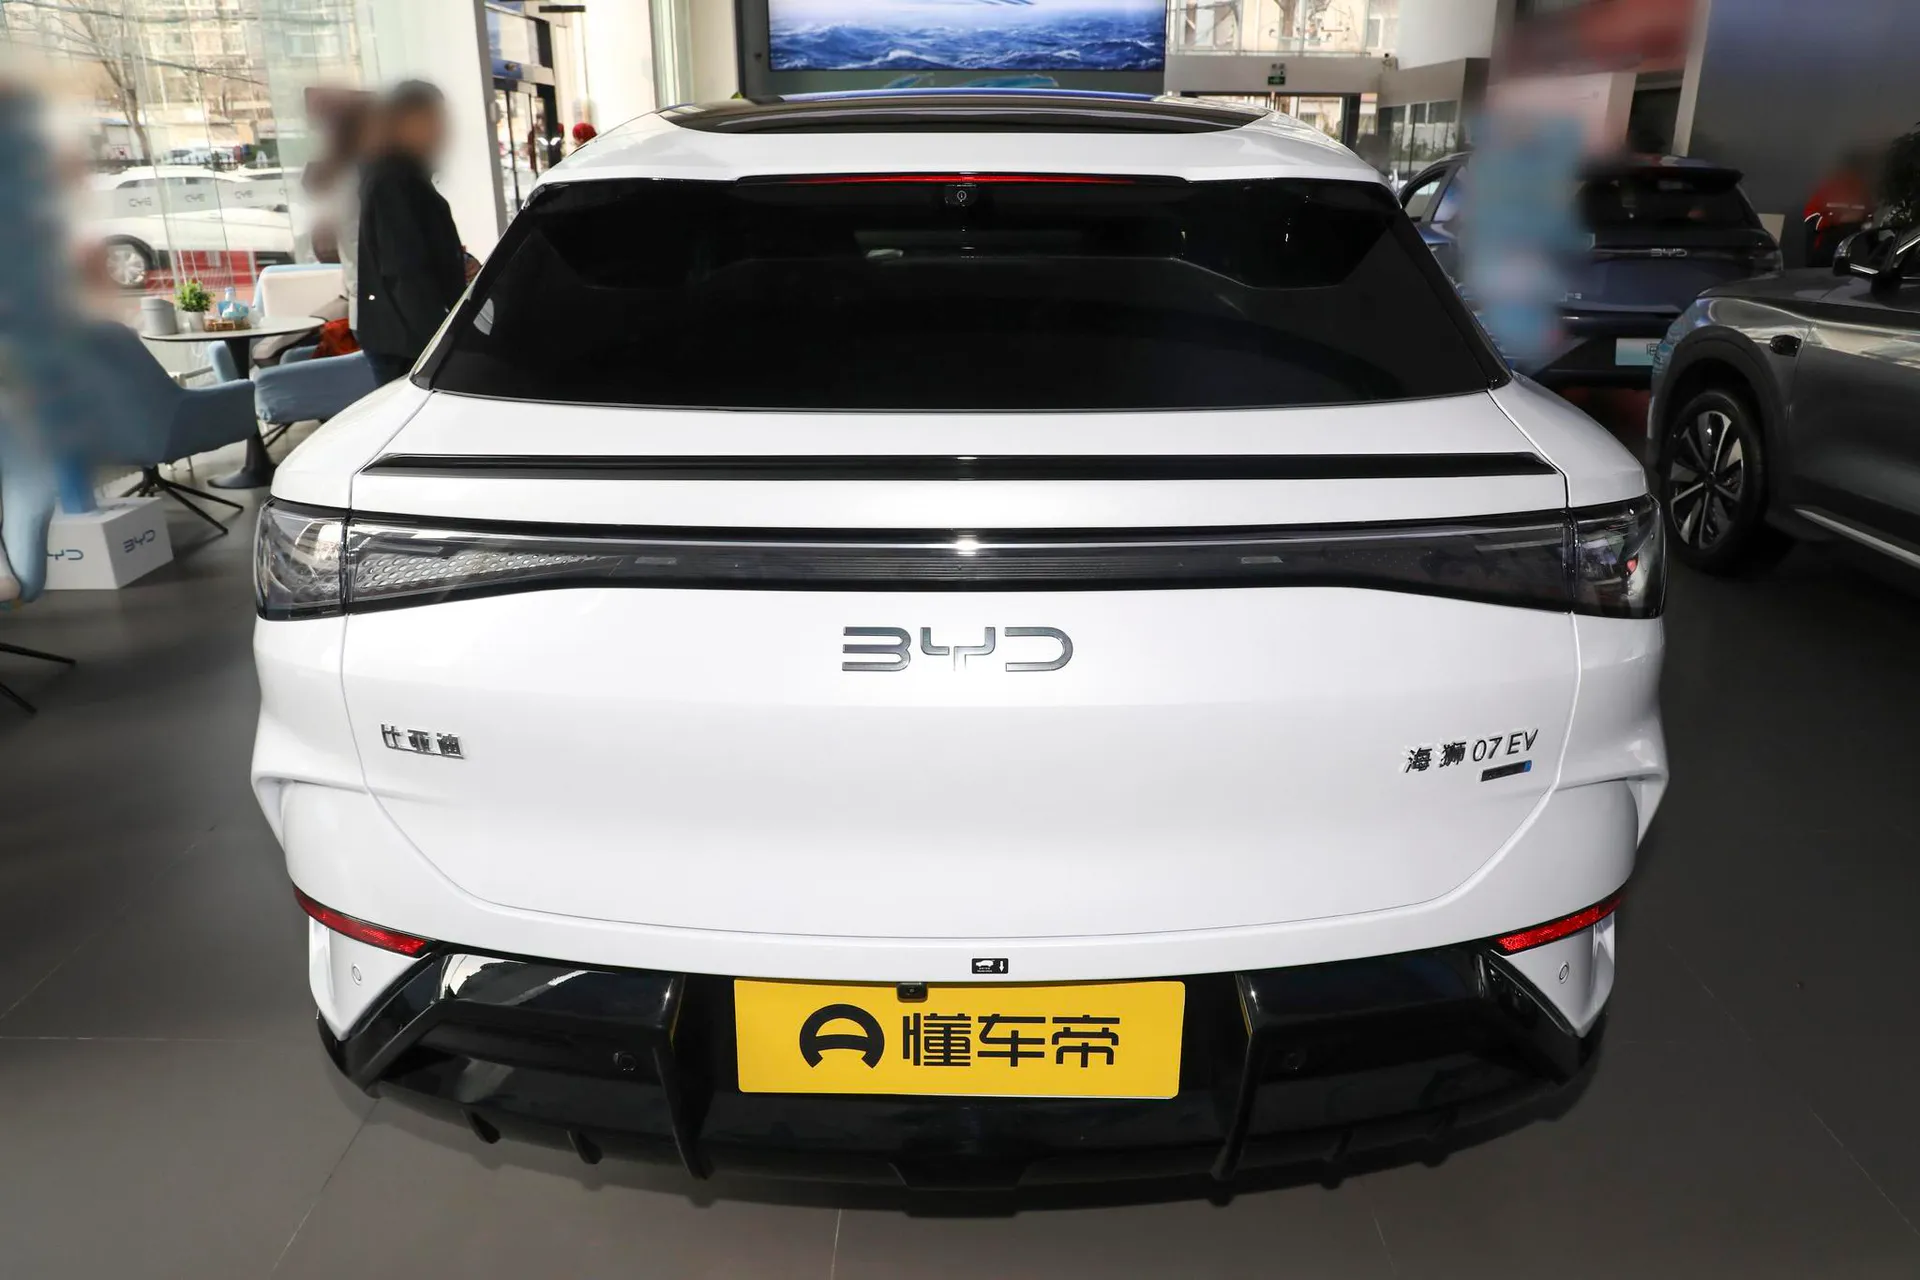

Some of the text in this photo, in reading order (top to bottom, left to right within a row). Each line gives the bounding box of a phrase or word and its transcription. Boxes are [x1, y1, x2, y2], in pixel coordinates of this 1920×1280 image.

[1650, 248, 1688, 257] BYD
[47, 549, 84, 561] YD
[123, 529, 156, 553] BYD
[842, 626, 1074, 672] BYD
[380, 723, 464, 759] 比亚迪
[902, 1012, 1121, 1068] 懂车帝
